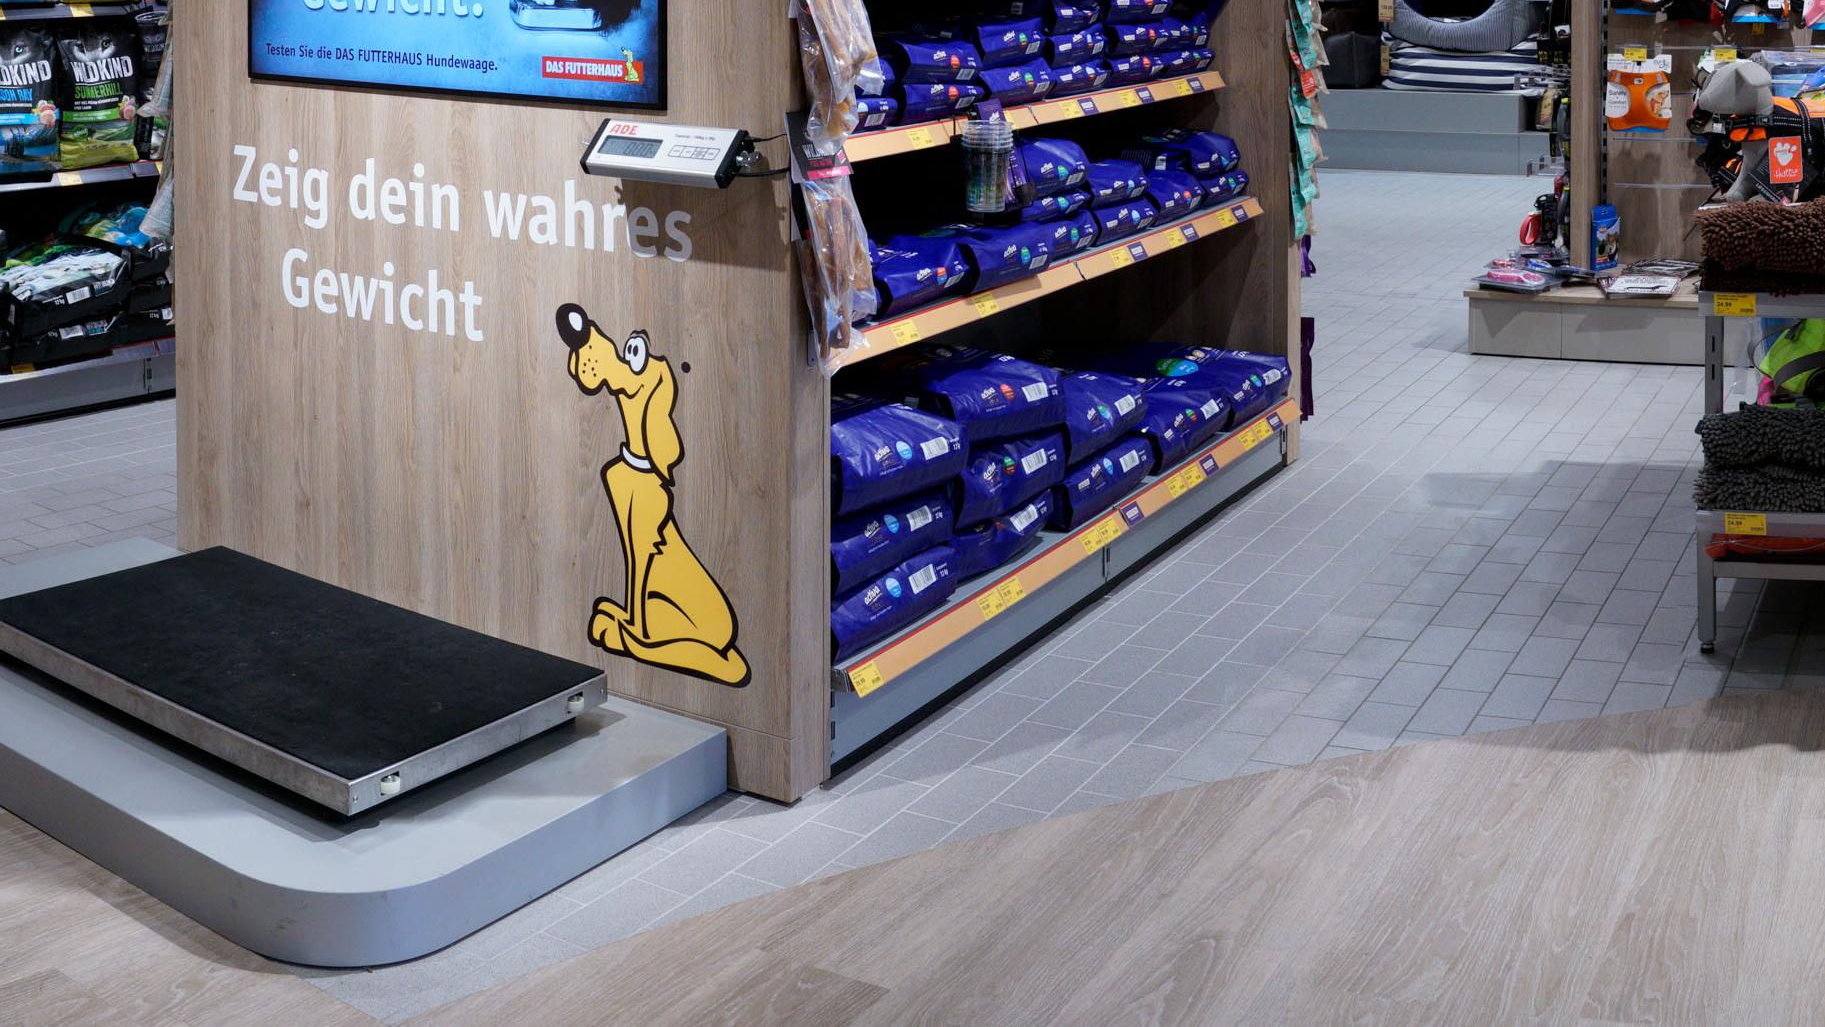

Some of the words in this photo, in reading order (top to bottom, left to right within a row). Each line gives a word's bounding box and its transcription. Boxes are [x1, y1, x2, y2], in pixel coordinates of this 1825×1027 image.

[266, 42, 296, 58] Testen
[299, 44, 314, 59] Sie
[316, 45, 332, 60] die
[335, 47, 355, 62] DAS
[358, 49, 423, 66] FUTTERHAUS
[426, 53, 498, 72] Hundewaage.
[545, 59, 564, 74] DAS
[564, 61, 623, 77] FUTTERHAUS
[609, 124, 639, 135] ADE
[233, 144, 328, 229] Zeig
[348, 157, 460, 232] dein
[483, 179, 693, 262] wahres
[282, 247, 484, 341] Gewicht
